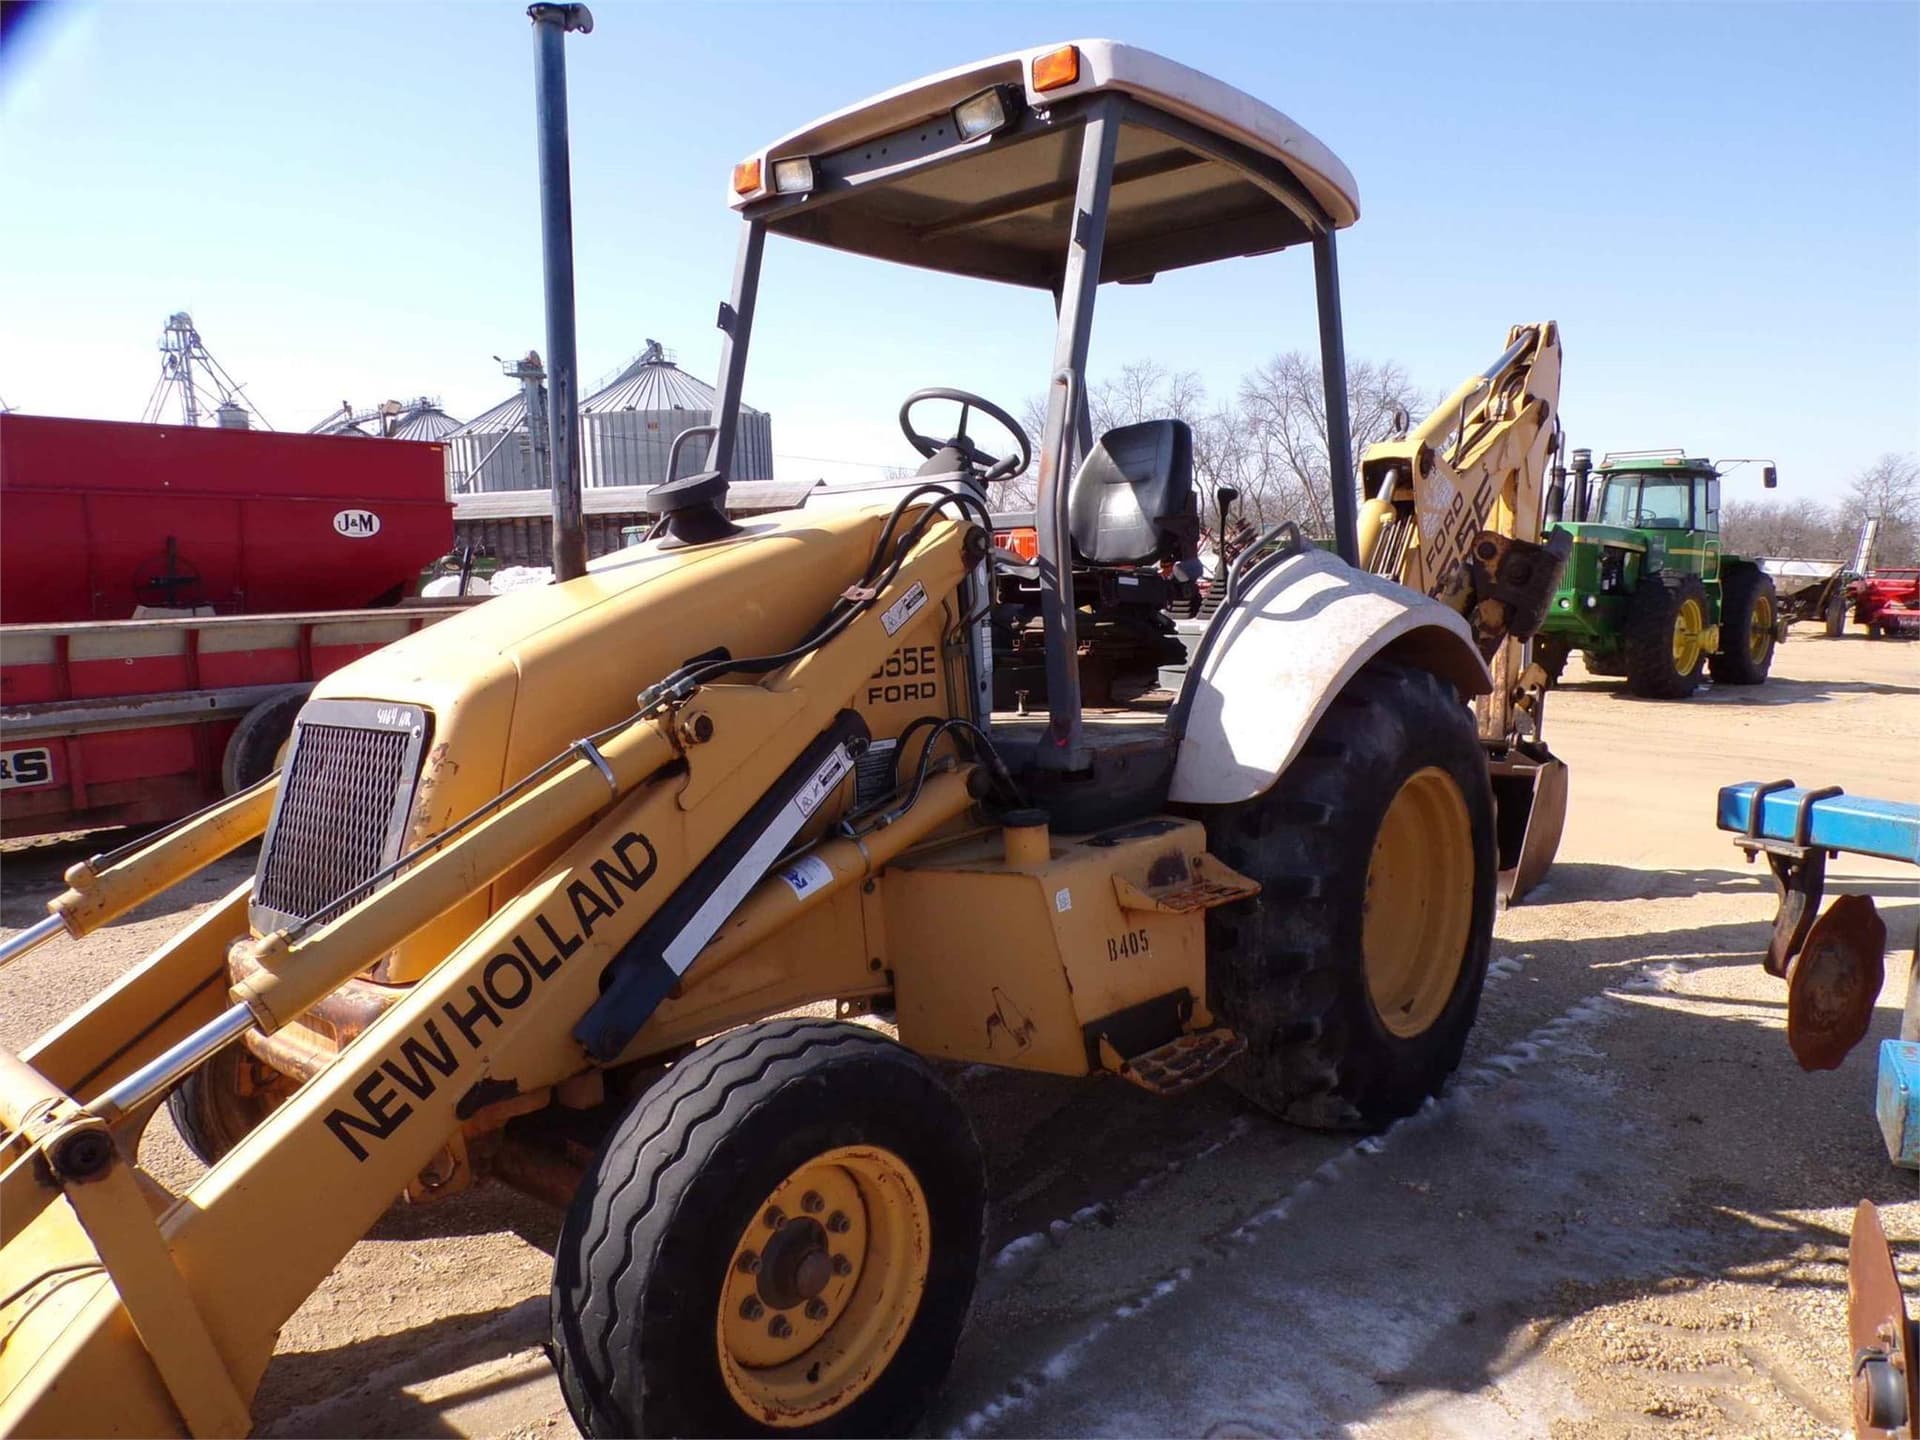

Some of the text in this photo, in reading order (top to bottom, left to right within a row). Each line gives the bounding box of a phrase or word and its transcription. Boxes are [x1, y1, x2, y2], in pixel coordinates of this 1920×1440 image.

[337, 513, 374, 532] J&M
[1426, 491, 1463, 573] FORD
[867, 682, 937, 705] FORD
[1106, 929, 1149, 962] B405
[323, 831, 658, 1163] NEW HOLLAND
